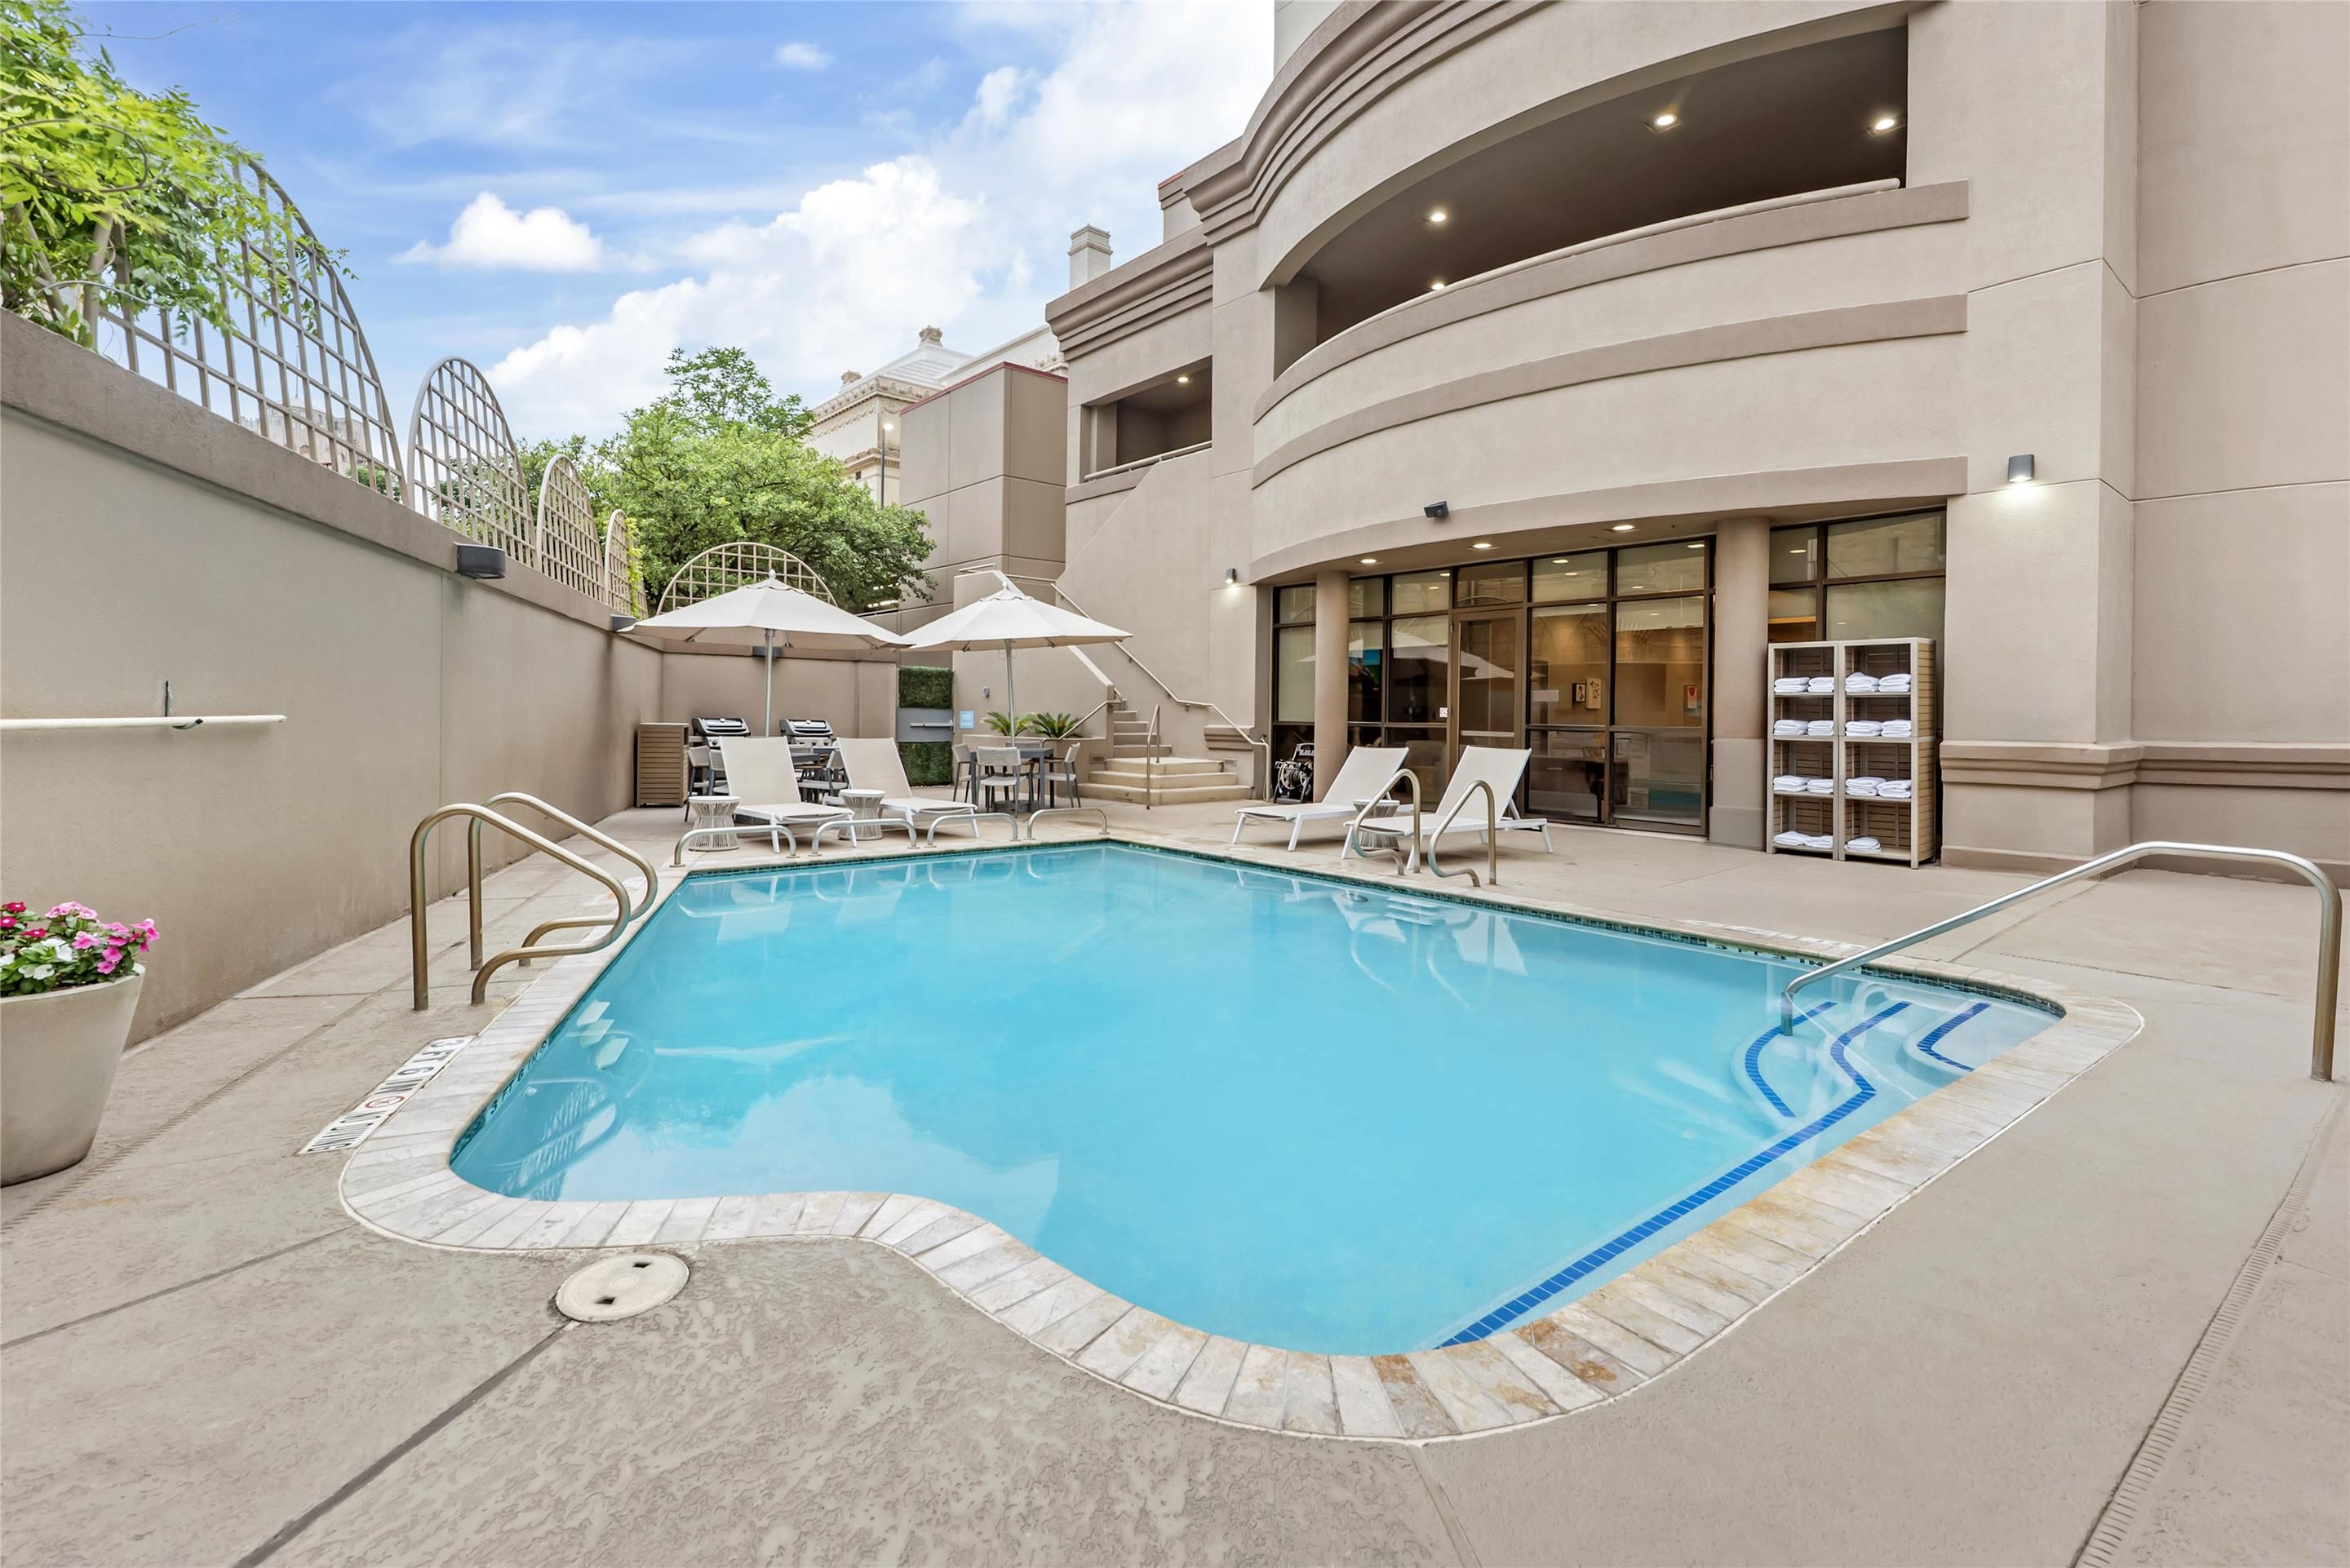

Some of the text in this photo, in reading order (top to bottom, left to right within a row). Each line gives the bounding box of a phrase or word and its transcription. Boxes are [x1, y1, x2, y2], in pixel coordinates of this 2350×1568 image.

[375, 1039, 465, 1095] 3 FT 6 IN
[490, 1052, 539, 1114] 3 FT 6 IN
[307, 1110, 388, 1152] NO DIVING
